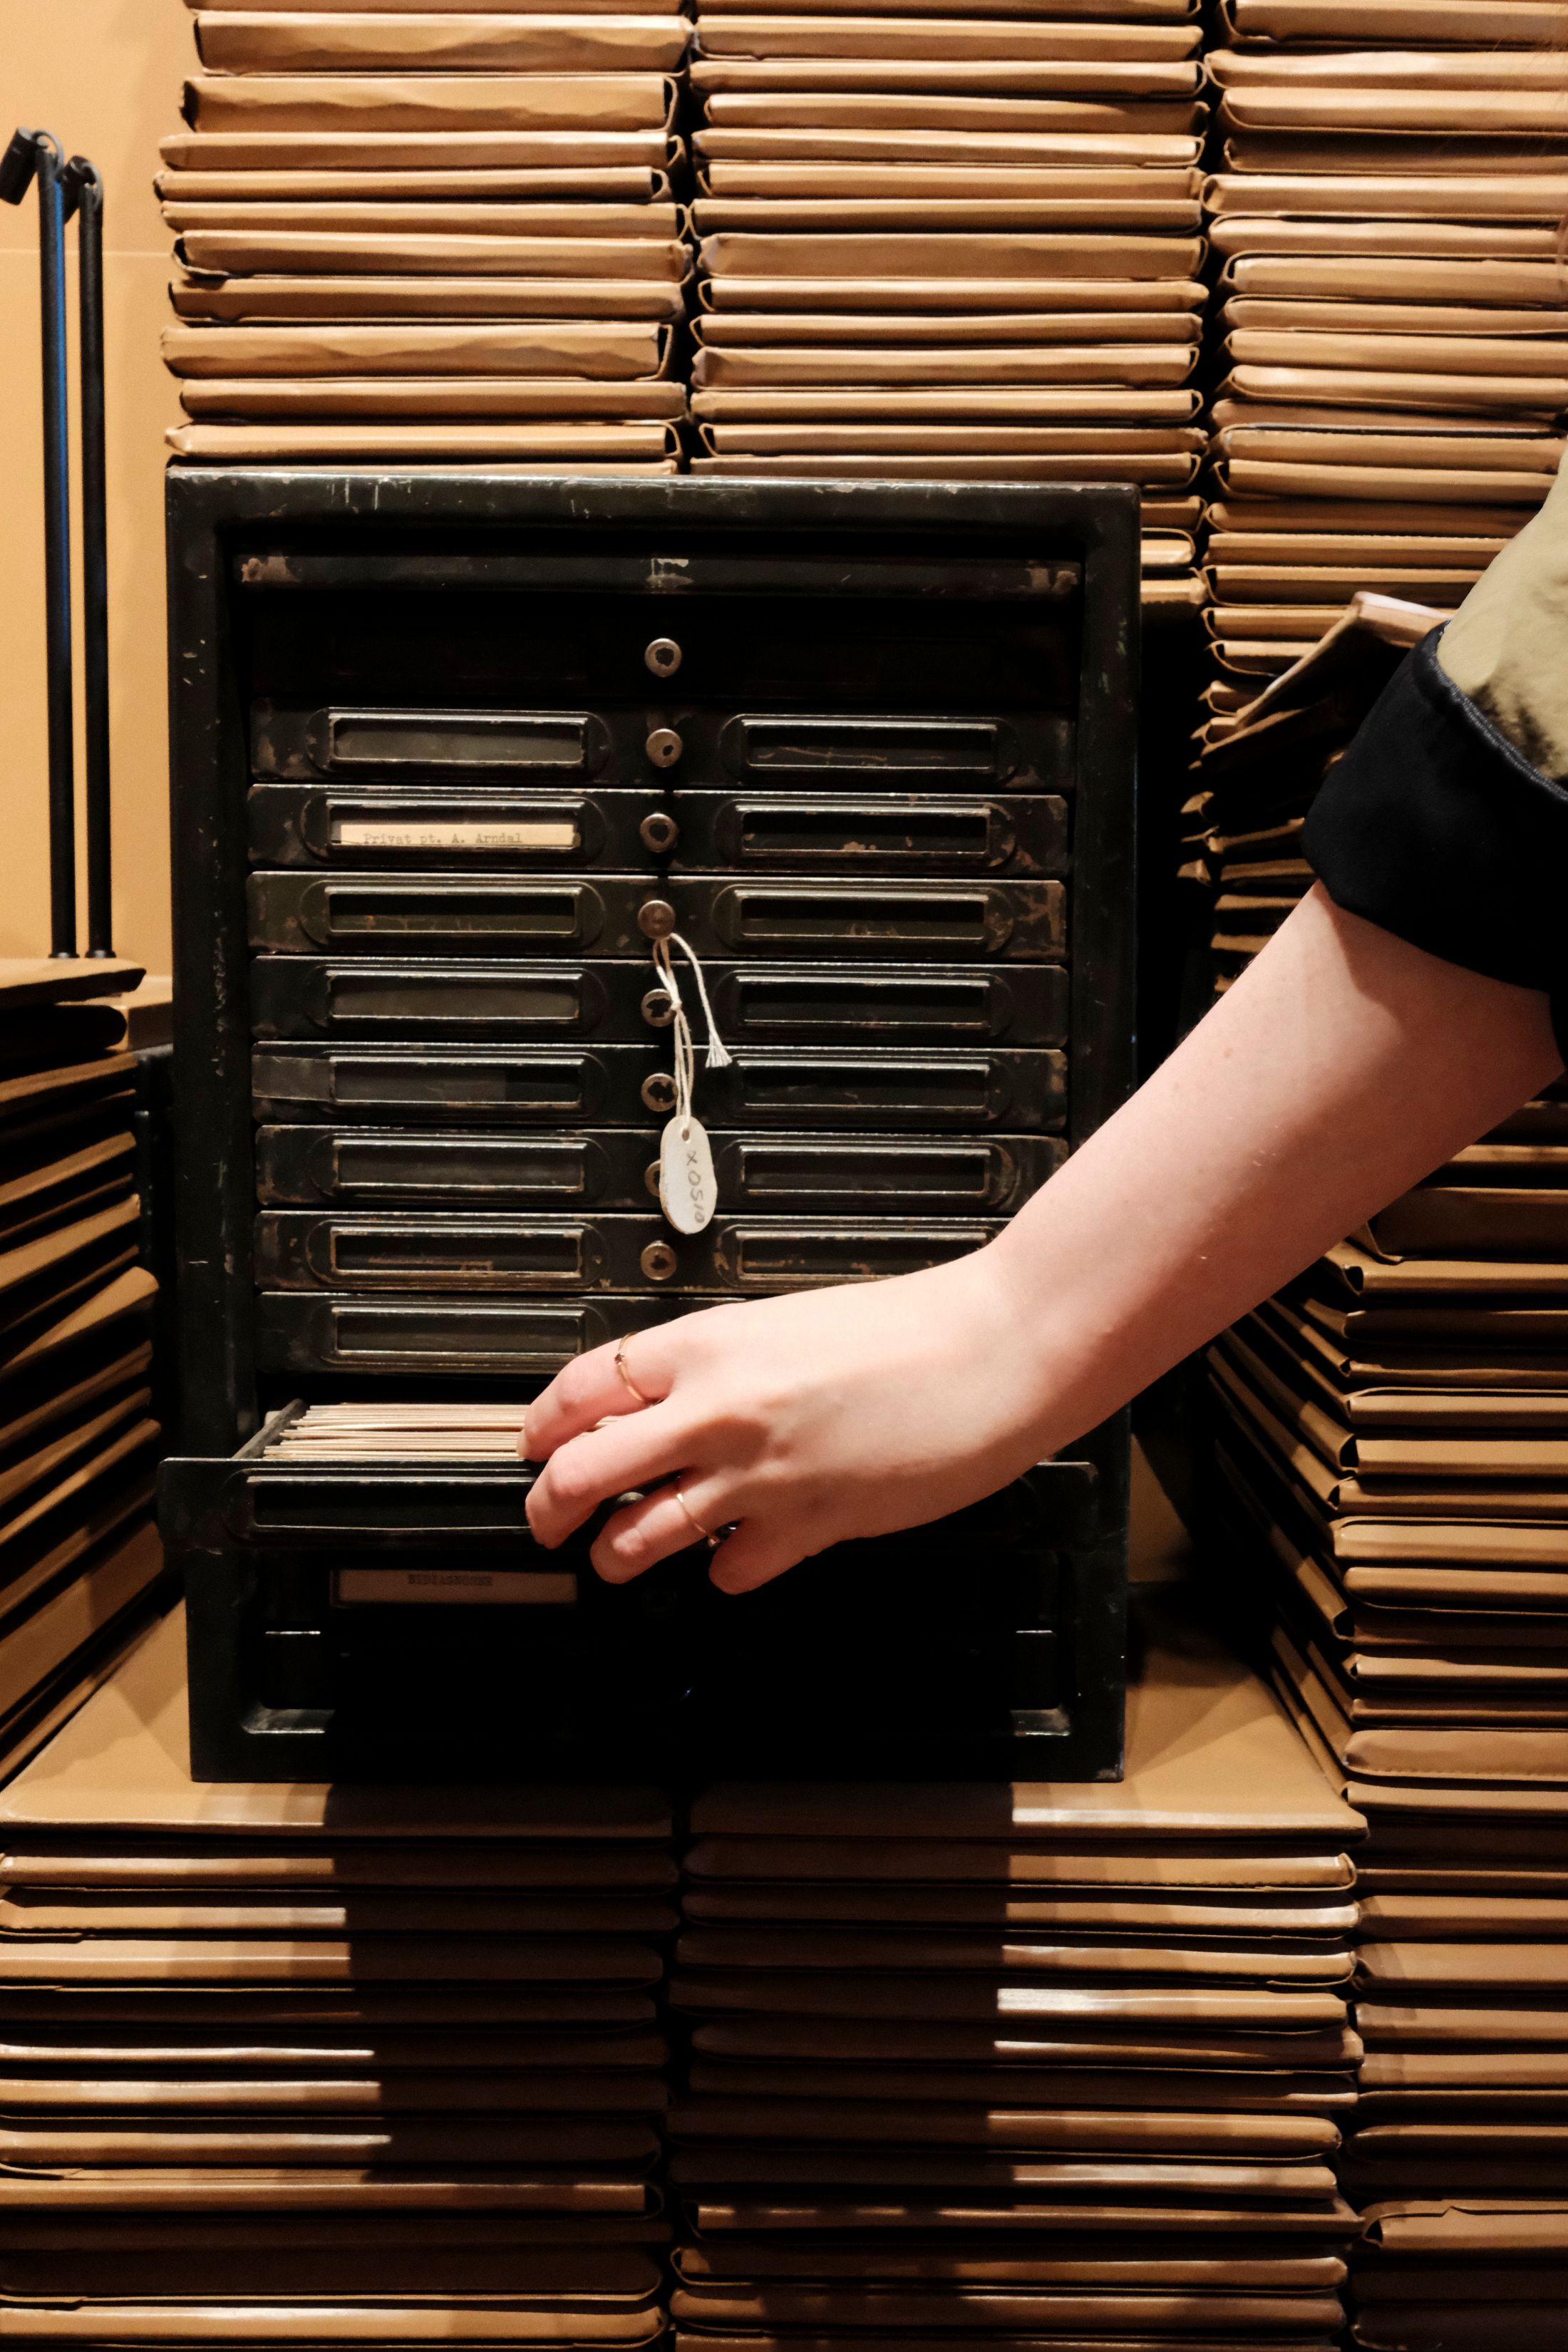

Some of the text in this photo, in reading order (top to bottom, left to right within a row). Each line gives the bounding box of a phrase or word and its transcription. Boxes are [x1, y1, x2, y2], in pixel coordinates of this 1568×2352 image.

[363, 832, 522, 846] Privat pt. A. Arndal
